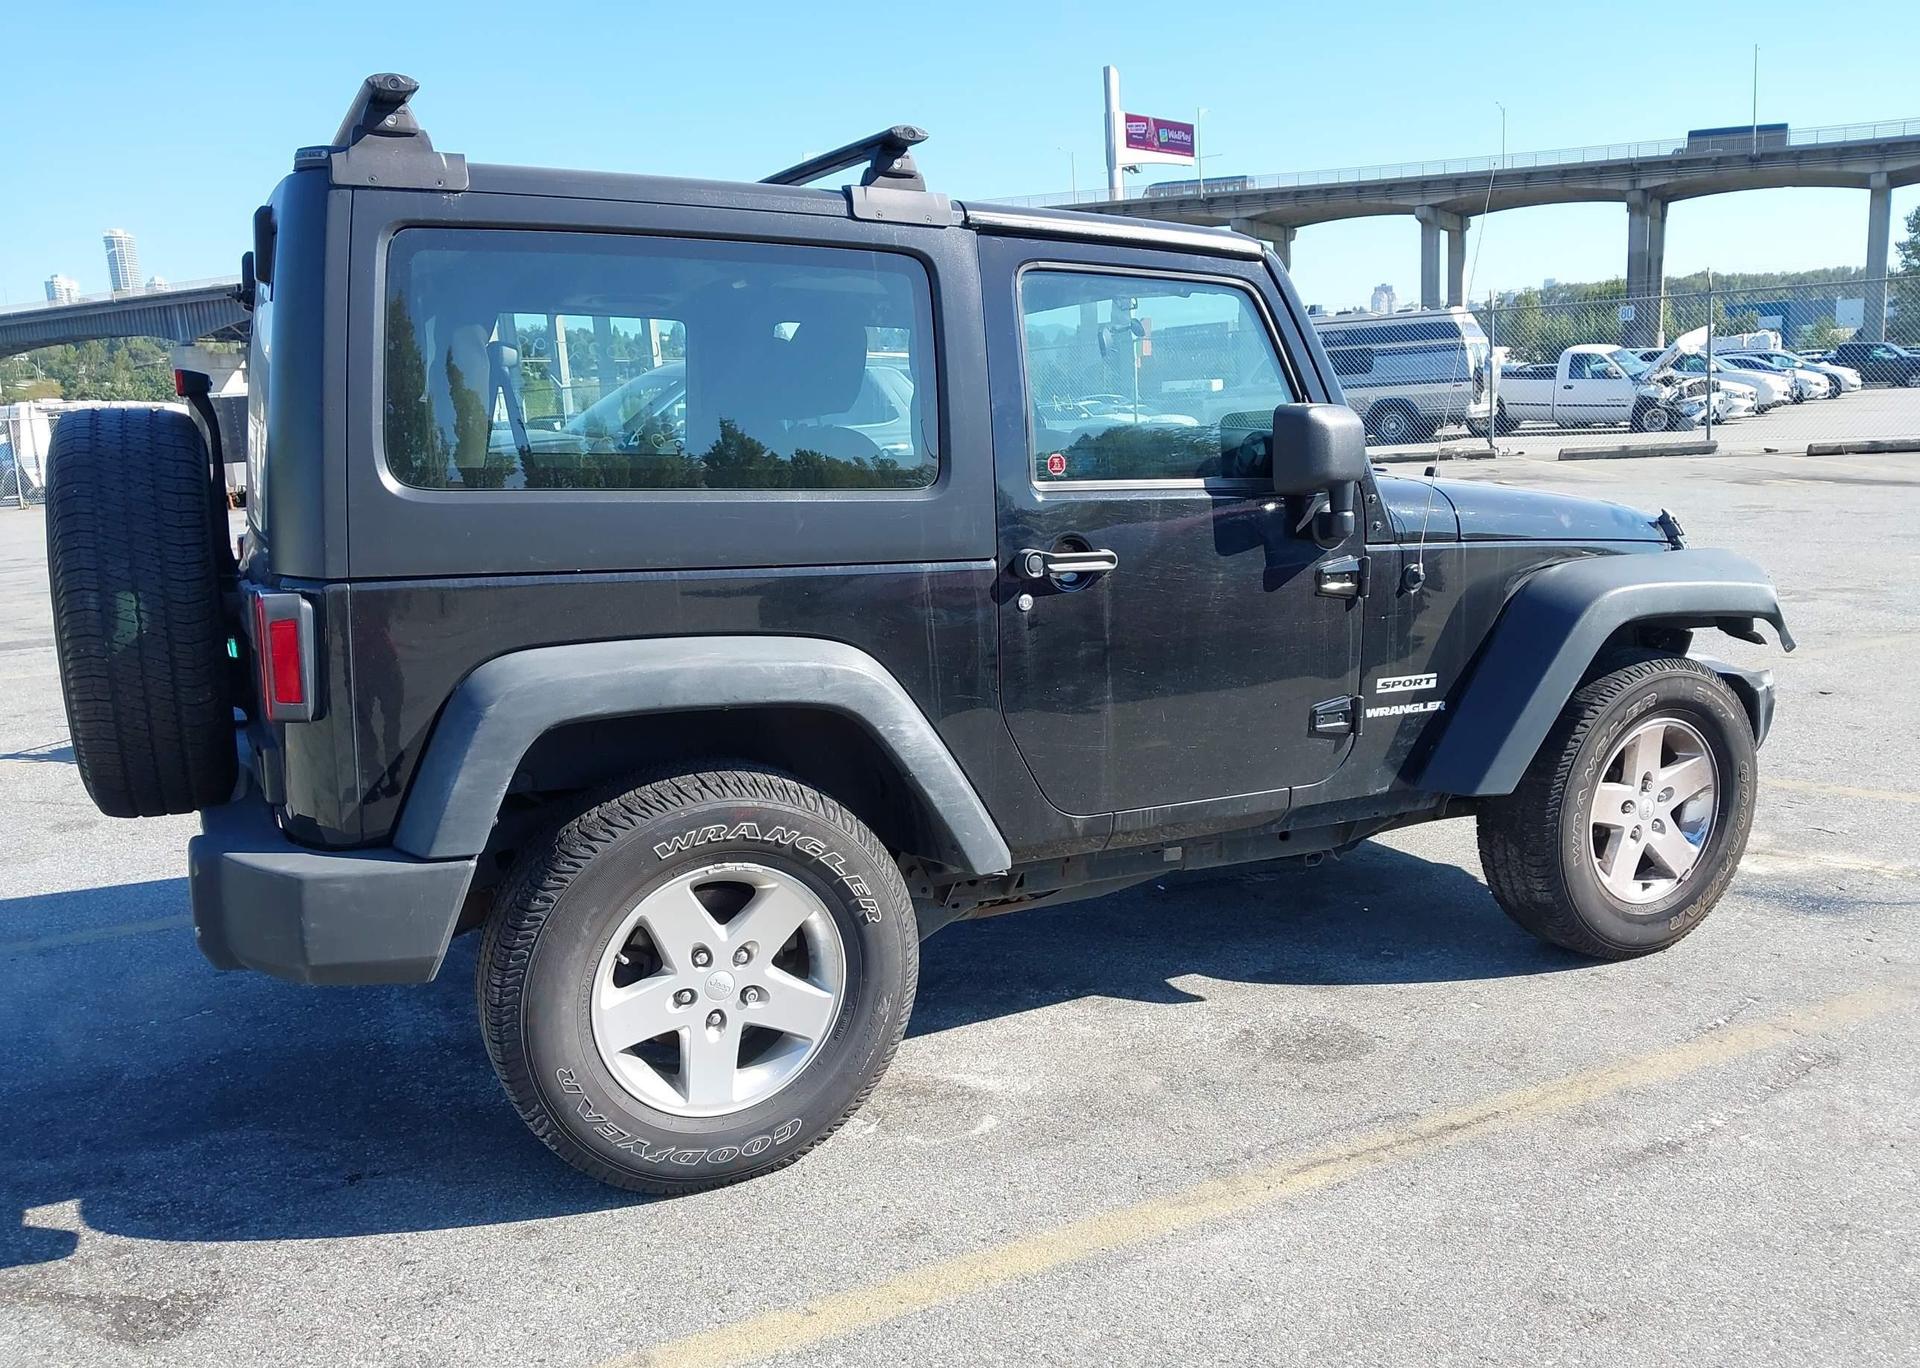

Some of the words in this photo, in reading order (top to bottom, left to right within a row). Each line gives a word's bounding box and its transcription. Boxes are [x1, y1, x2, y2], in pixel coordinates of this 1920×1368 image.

[1620, 307, 1633, 319] 80
[1381, 677, 1433, 690] SPORT
[1366, 700, 1446, 718] WRANGLER
[652, 822, 882, 925] WRANGLER
[555, 1067, 803, 1167] GOODYEAR
